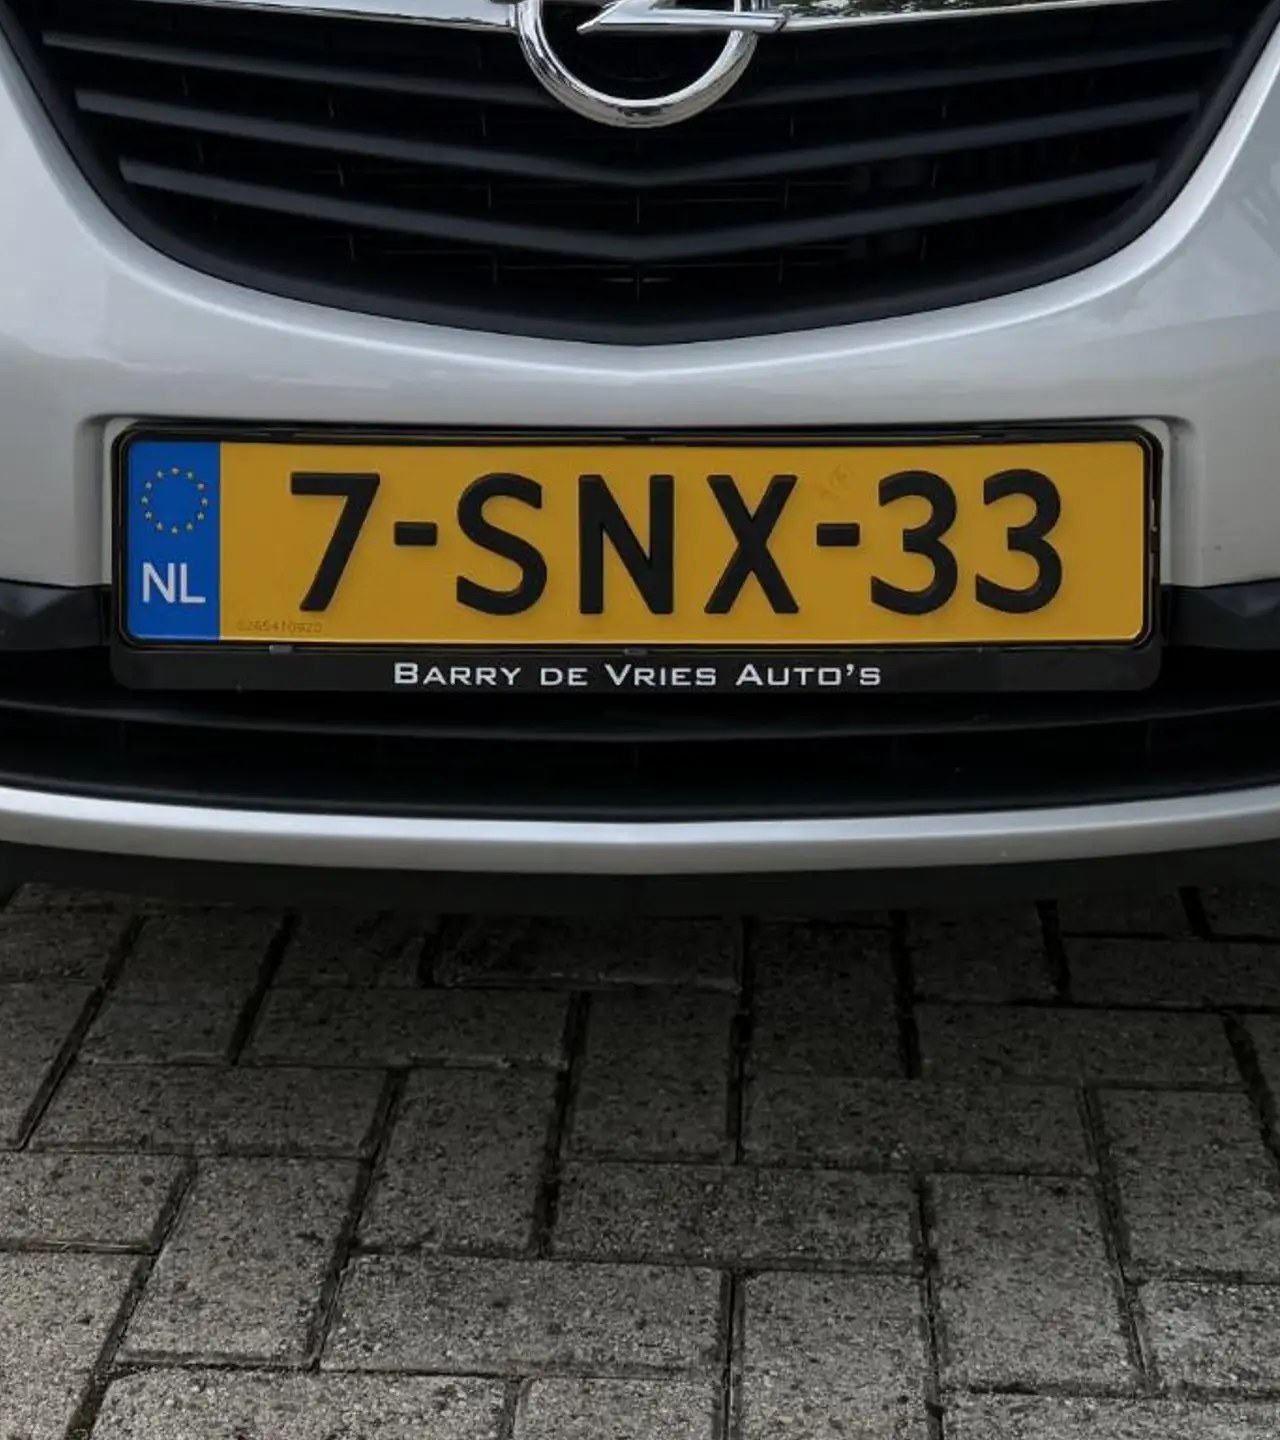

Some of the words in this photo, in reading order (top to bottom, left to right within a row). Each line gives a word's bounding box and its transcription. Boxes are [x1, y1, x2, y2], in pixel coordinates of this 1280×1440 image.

[288, 468, 1064, 618] 7-SNX-33
[142, 561, 206, 604] NL
[393, 662, 522, 686] BARRY
[604, 663, 717, 686] VRIES
[734, 662, 882, 687] AUTO'S
